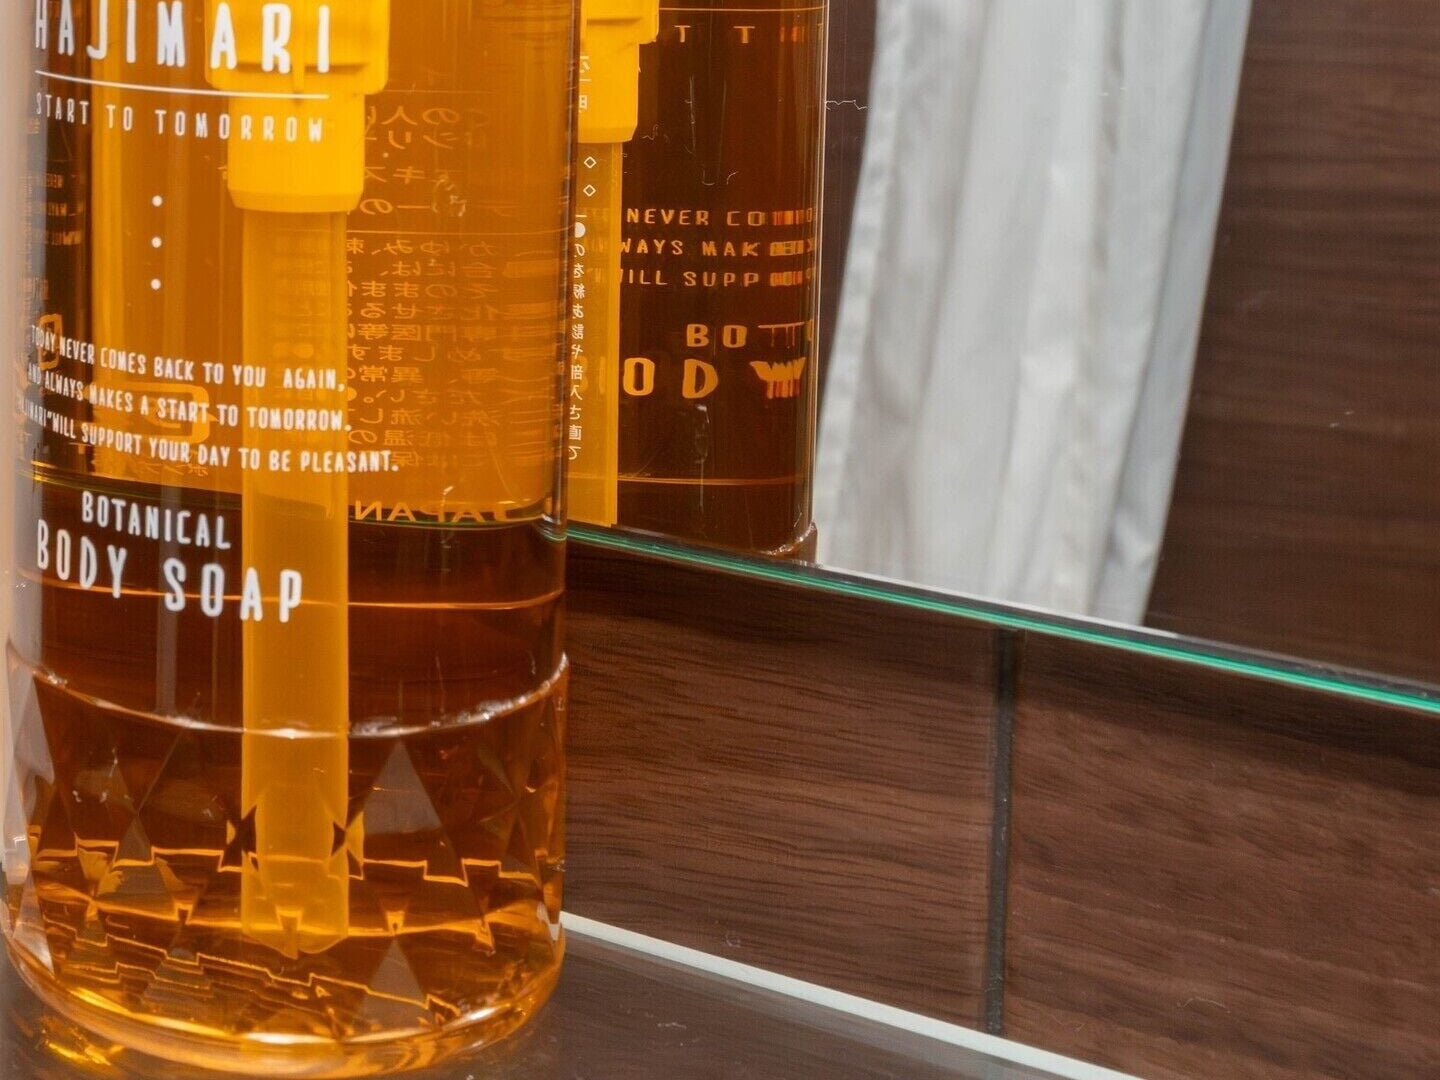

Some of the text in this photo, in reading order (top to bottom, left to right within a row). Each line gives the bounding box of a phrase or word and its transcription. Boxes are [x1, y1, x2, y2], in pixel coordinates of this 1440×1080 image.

[36, 92, 323, 142] START TO TOMORROW
[626, 208, 709, 226] NEVER
[32, 325, 56, 353] TODAY
[60, 337, 95, 365] NEVER
[100, 347, 146, 375] COMES
[154, 356, 194, 382] BACK
[203, 361, 224, 385] TO
[233, 364, 266, 388] YOU
[283, 367, 345, 392] AGAIN,
[45, 371, 84, 401] ALWAYS
[89, 381, 133, 412] MAKES
[140, 396, 149, 415] A
[157, 398, 210, 424] START
[217, 404, 238, 426] TO
[247, 406, 352, 432] TOMORROW.
[82, 422, 141, 455] SUPPORT
[149, 438, 191, 463] YOUR
[198, 445, 231, 468] DAY
[240, 448, 260, 470] TO
[269, 450, 291, 471] BE
[300, 450, 399, 473] PLEASANT.
[82, 490, 231, 550] BOTANICAL
[37, 519, 303, 623] BODY SOAP
